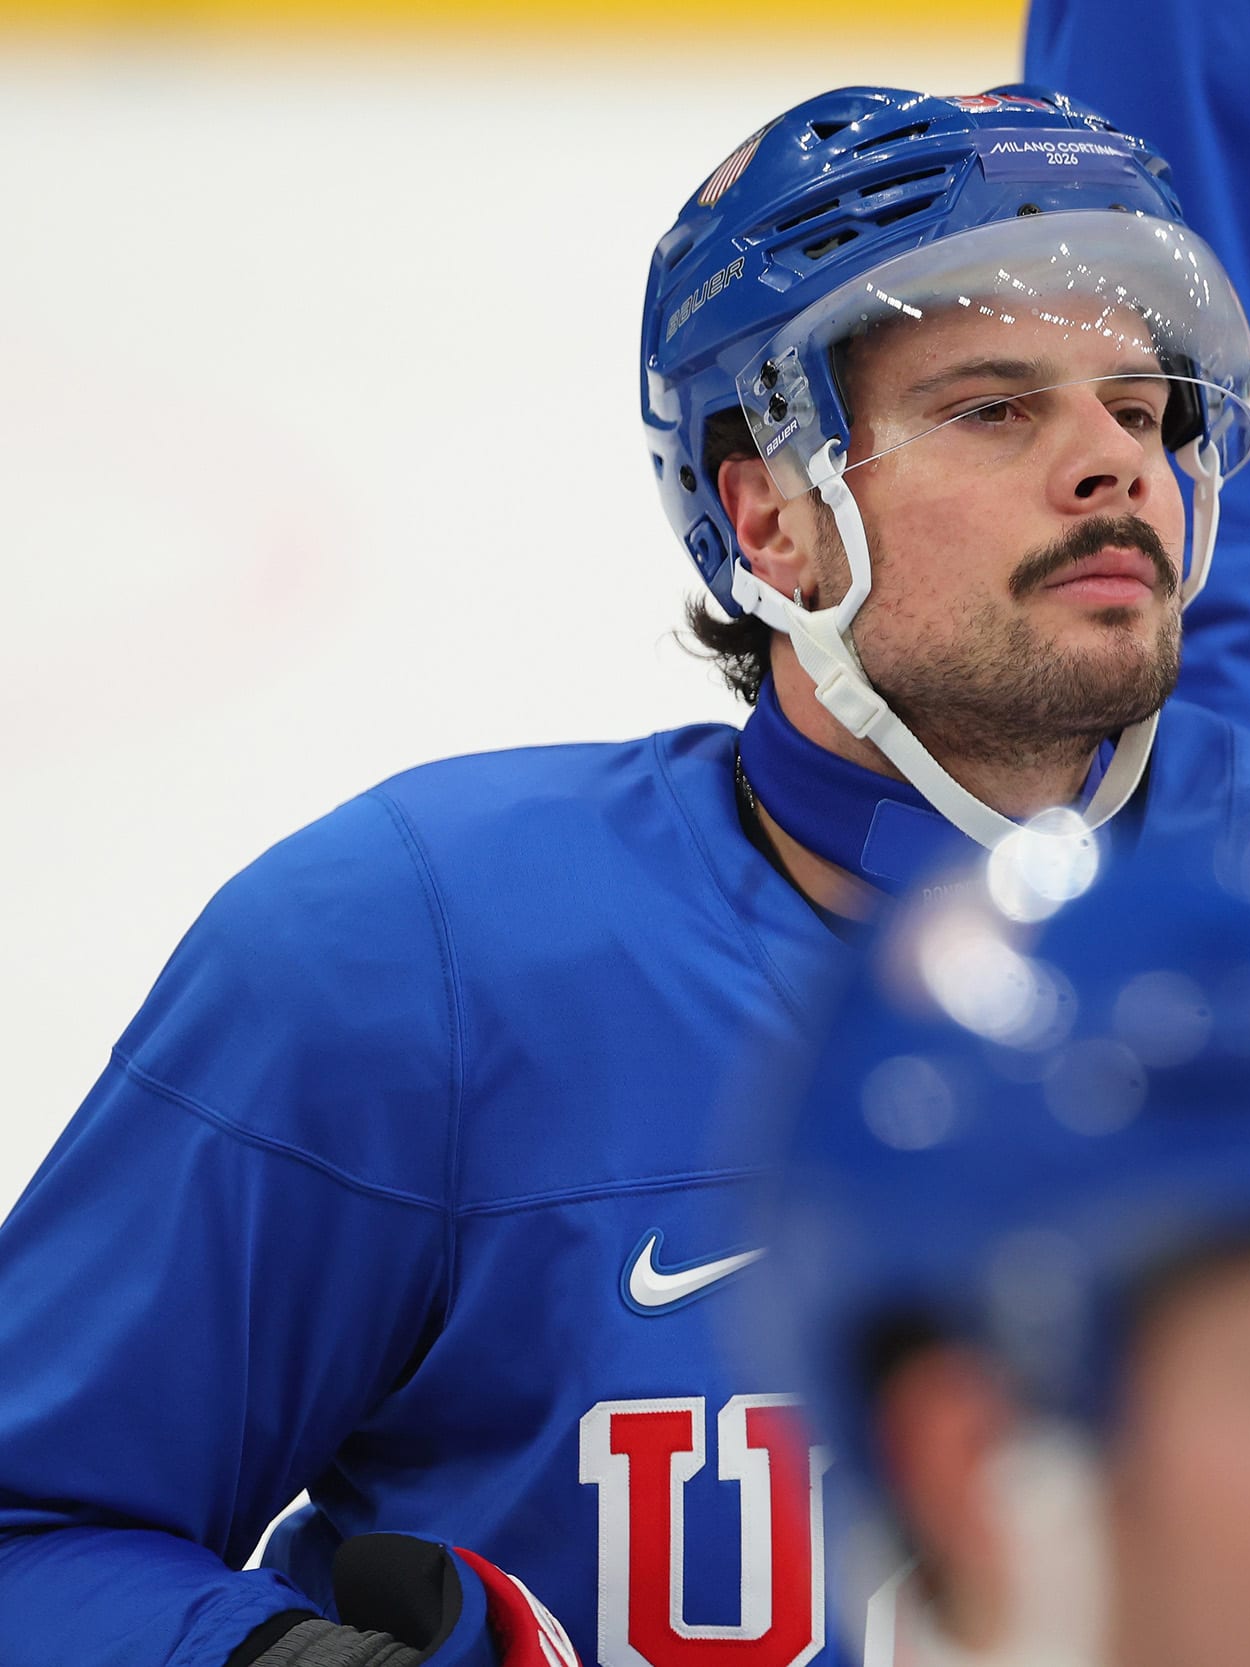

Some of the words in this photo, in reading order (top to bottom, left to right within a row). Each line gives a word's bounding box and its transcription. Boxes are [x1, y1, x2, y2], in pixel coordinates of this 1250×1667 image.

[990, 141, 1055, 154] MILANO
[1046, 153, 1078, 165] 2026
[665, 256, 745, 343] BAUER
[765, 419, 798, 457] BAUER
[579, 1393, 920, 1667] U
